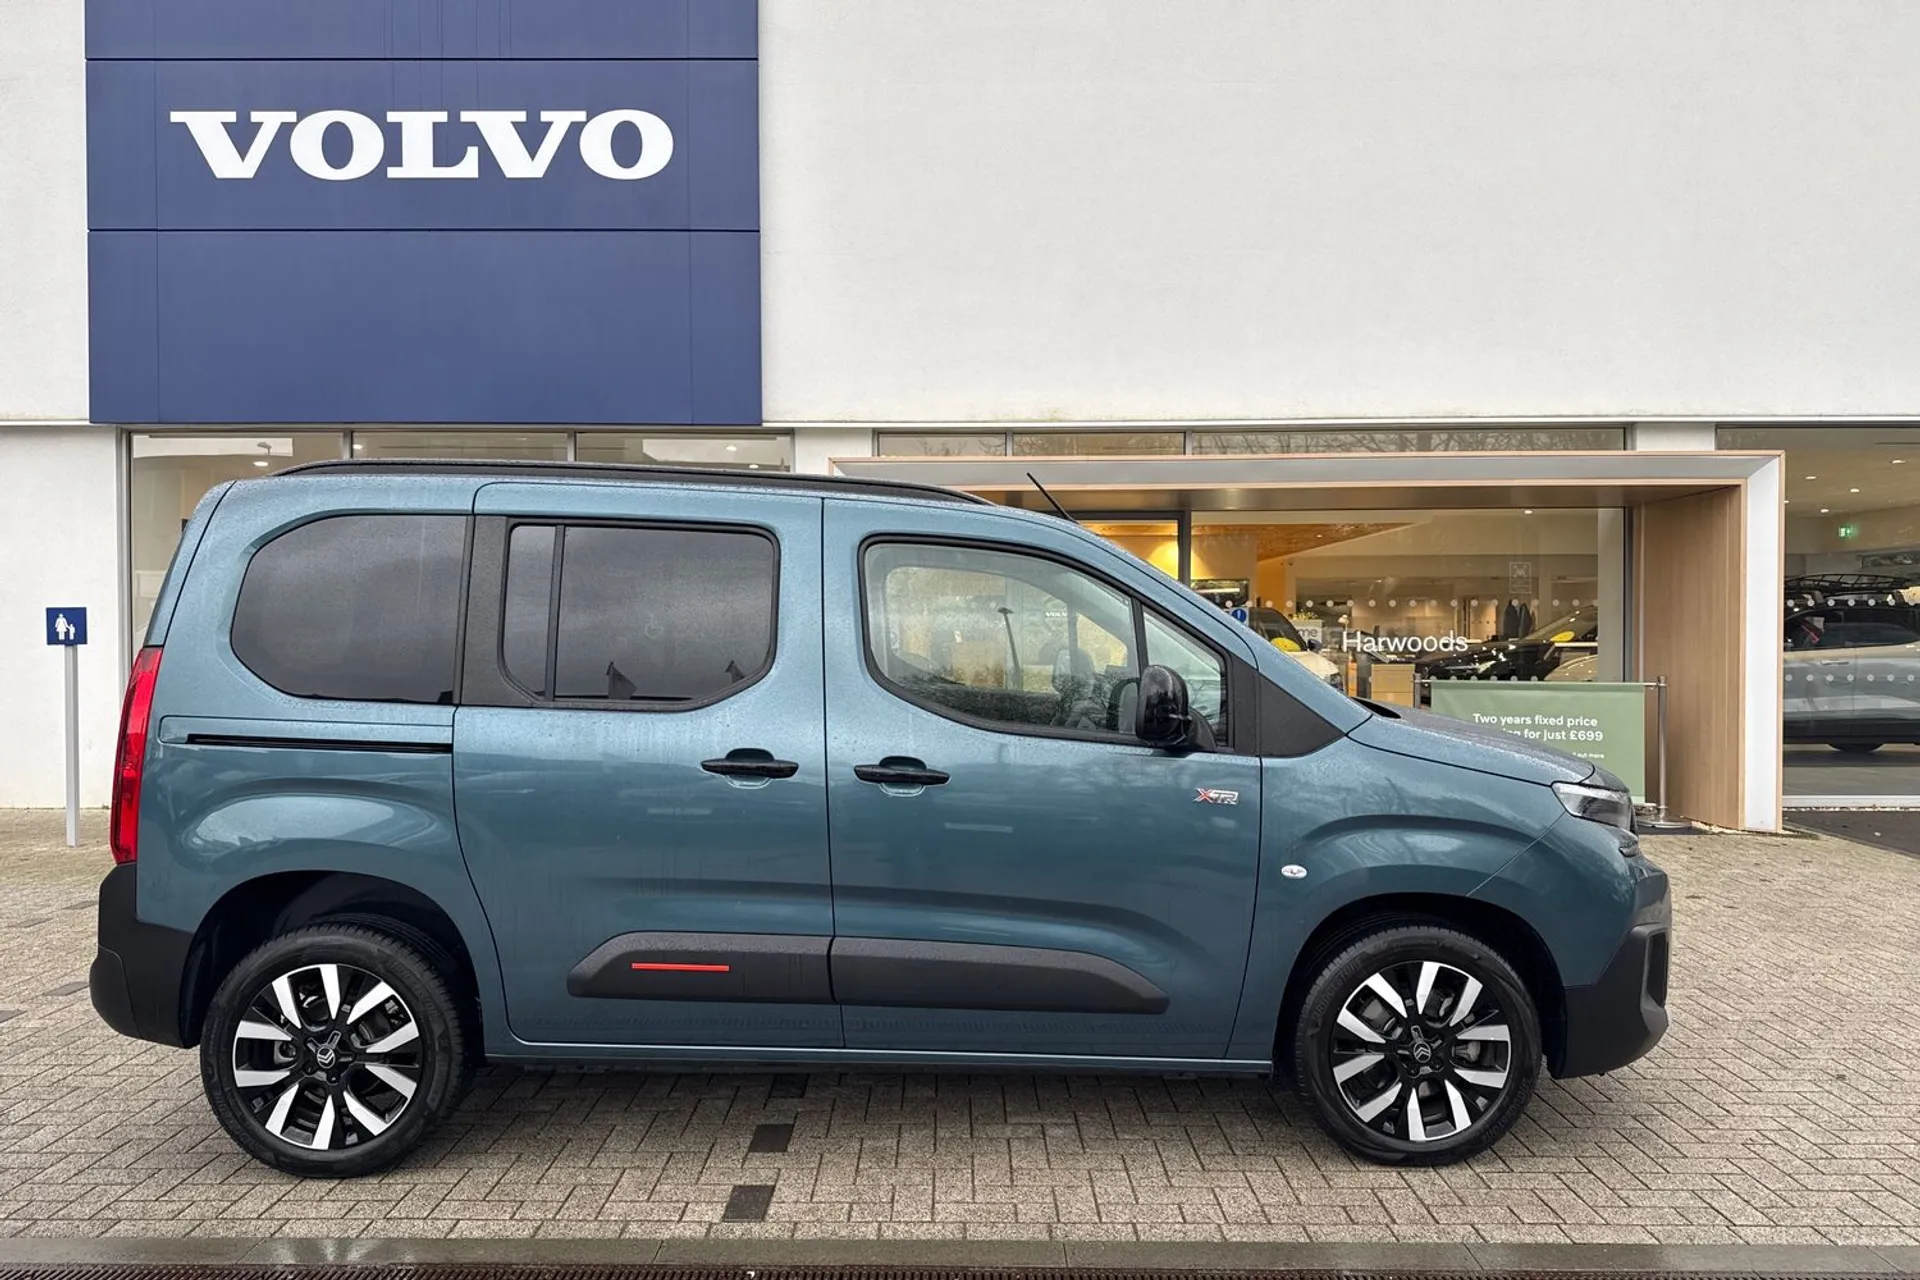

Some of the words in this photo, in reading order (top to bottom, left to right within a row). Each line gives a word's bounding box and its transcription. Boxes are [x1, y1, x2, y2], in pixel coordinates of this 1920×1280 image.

[170, 109, 674, 181] VOLVO
[1342, 630, 1468, 652] Harwoods
[1473, 713, 1497, 723] Two
[1500, 715, 1531, 726] years
[1535, 714, 1563, 725] fixed
[1567, 715, 1598, 728] price
[1524, 729, 1540, 739] for
[1543, 729, 1566, 741] just
[1570, 730, 1603, 741] £699
